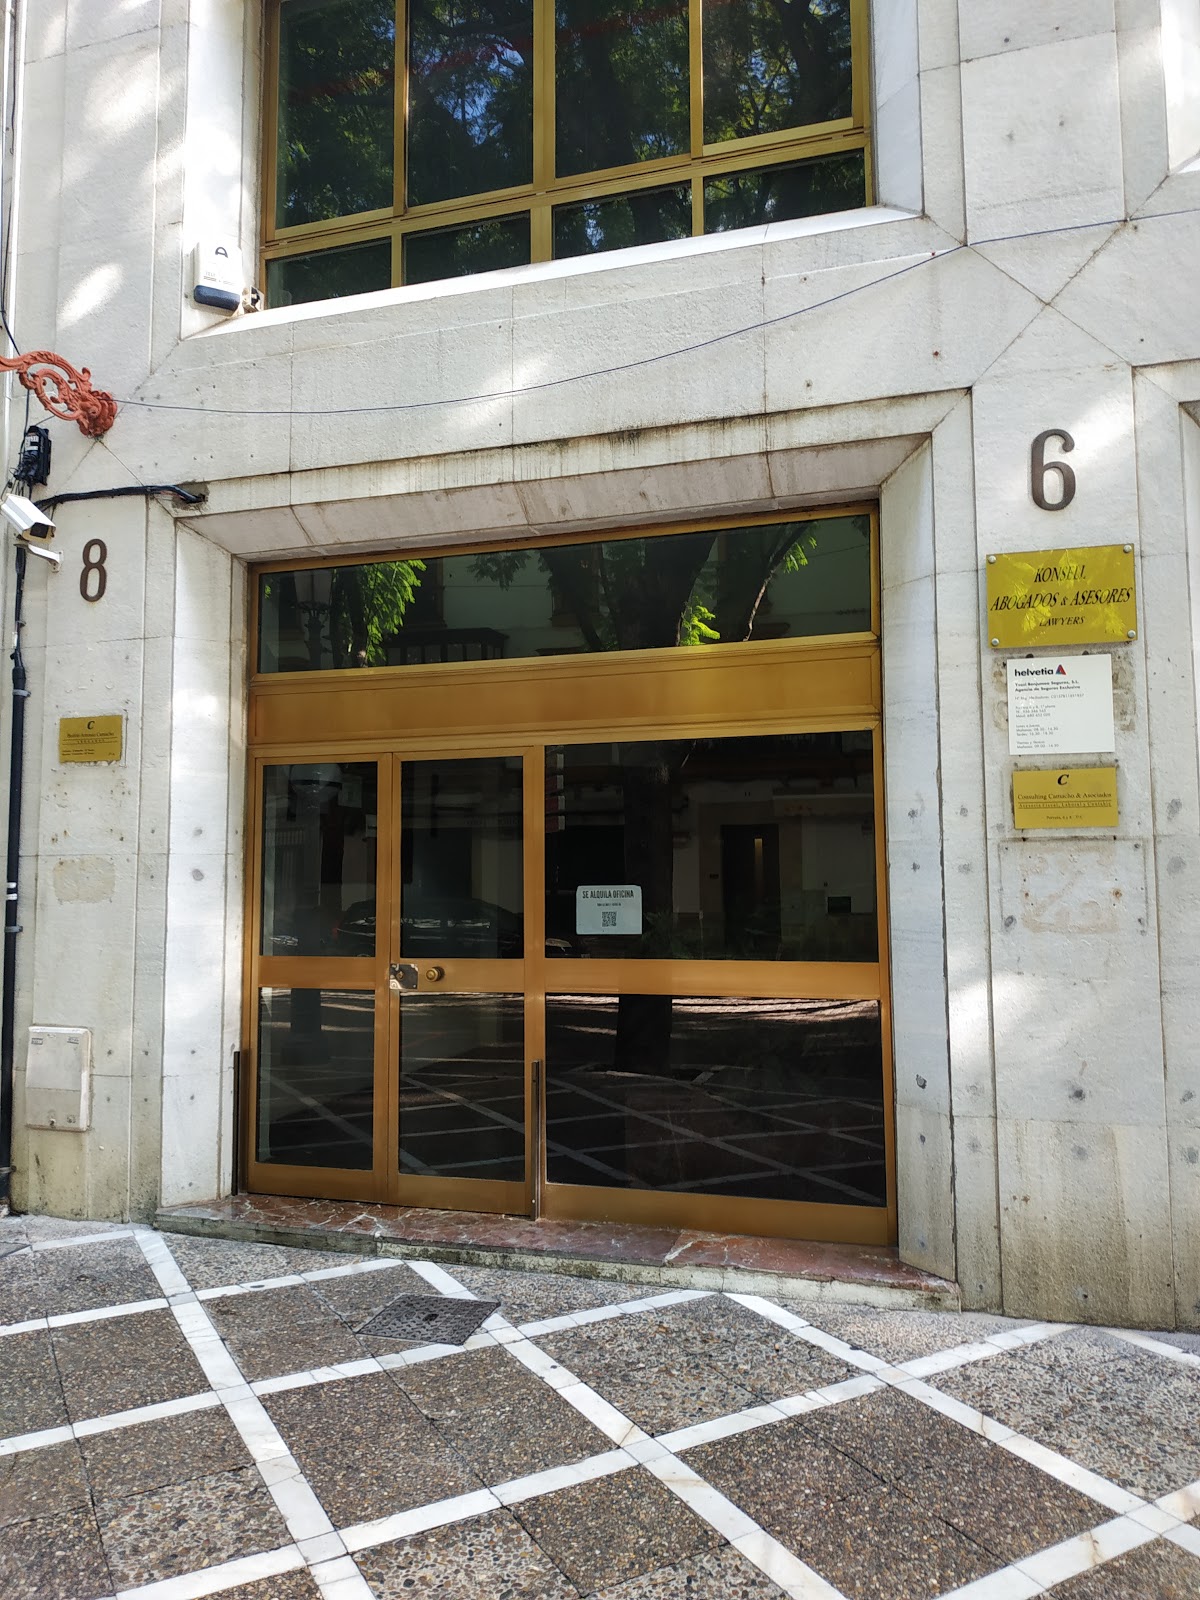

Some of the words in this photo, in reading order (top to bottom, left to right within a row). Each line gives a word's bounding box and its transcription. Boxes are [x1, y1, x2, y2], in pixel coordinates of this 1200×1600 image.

[1031, 428, 1076, 512] 6
[80, 538, 107, 602] 8
[990, 592, 1060, 611] ABOGADOS
[1060, 597, 1069, 605] &
[1070, 587, 1133, 606] ASESORES
[1039, 616, 1085, 627] LAWYERS
[1014, 667, 1054, 677] helvetia
[87, 720, 95, 730] C
[1057, 774, 1070, 786] C
[1017, 793, 1047, 801] Consulting
[1048, 792, 1075, 800] Camacho
[582, 891, 589, 899] SE
[590, 890, 612, 899] ALQUILA
[613, 890, 634, 898] OFICINA
